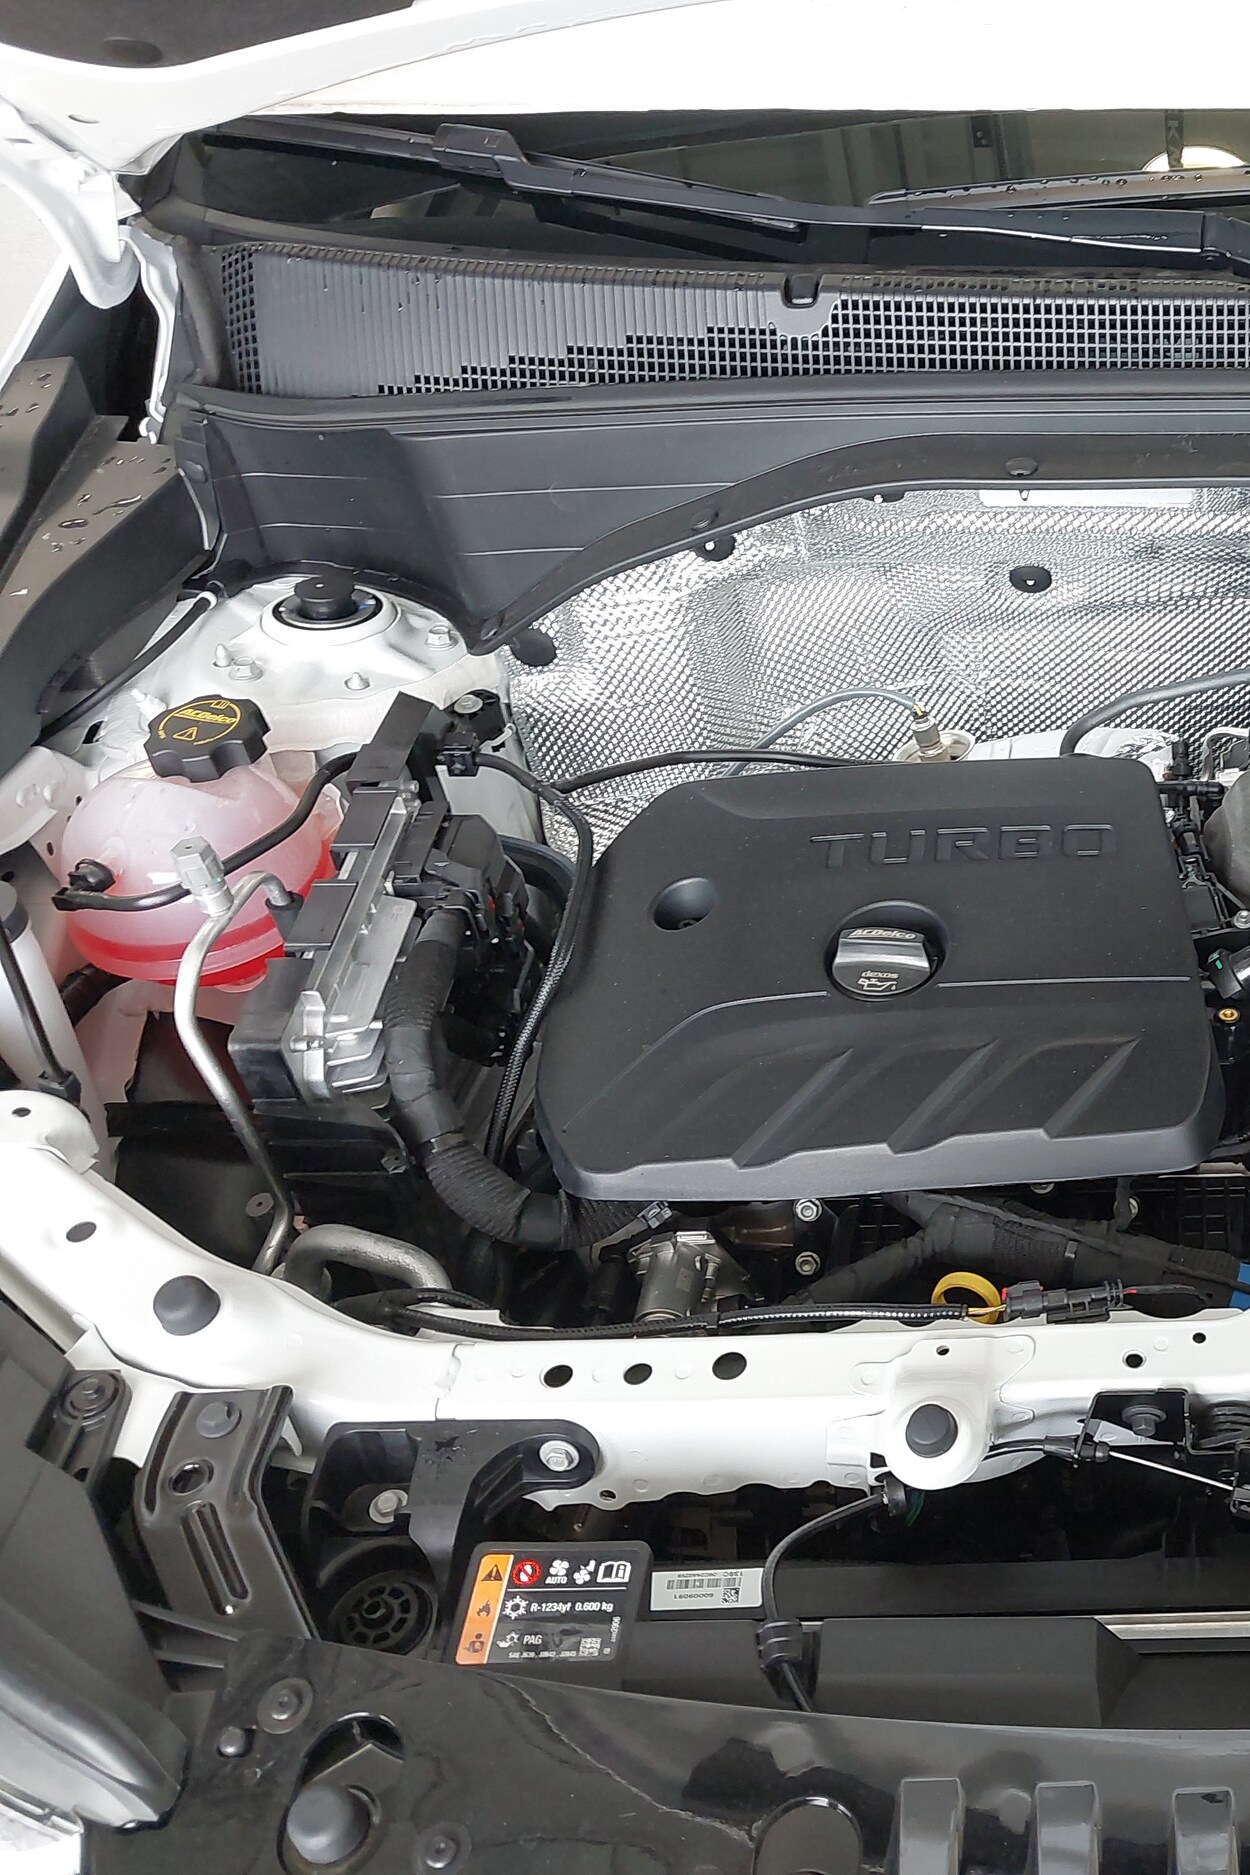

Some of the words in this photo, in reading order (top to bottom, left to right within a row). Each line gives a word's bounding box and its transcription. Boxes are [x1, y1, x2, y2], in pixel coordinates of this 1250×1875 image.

[809, 823, 1118, 868] TURBO
[861, 970, 900, 979] dexos
[545, 1576, 568, 1585] AUTO
[530, 1602, 572, 1616] R-1234yf
[574, 1602, 601, 1612] 0.600
[601, 1602, 614, 1613] kg
[523, 1634, 543, 1645] PAG
